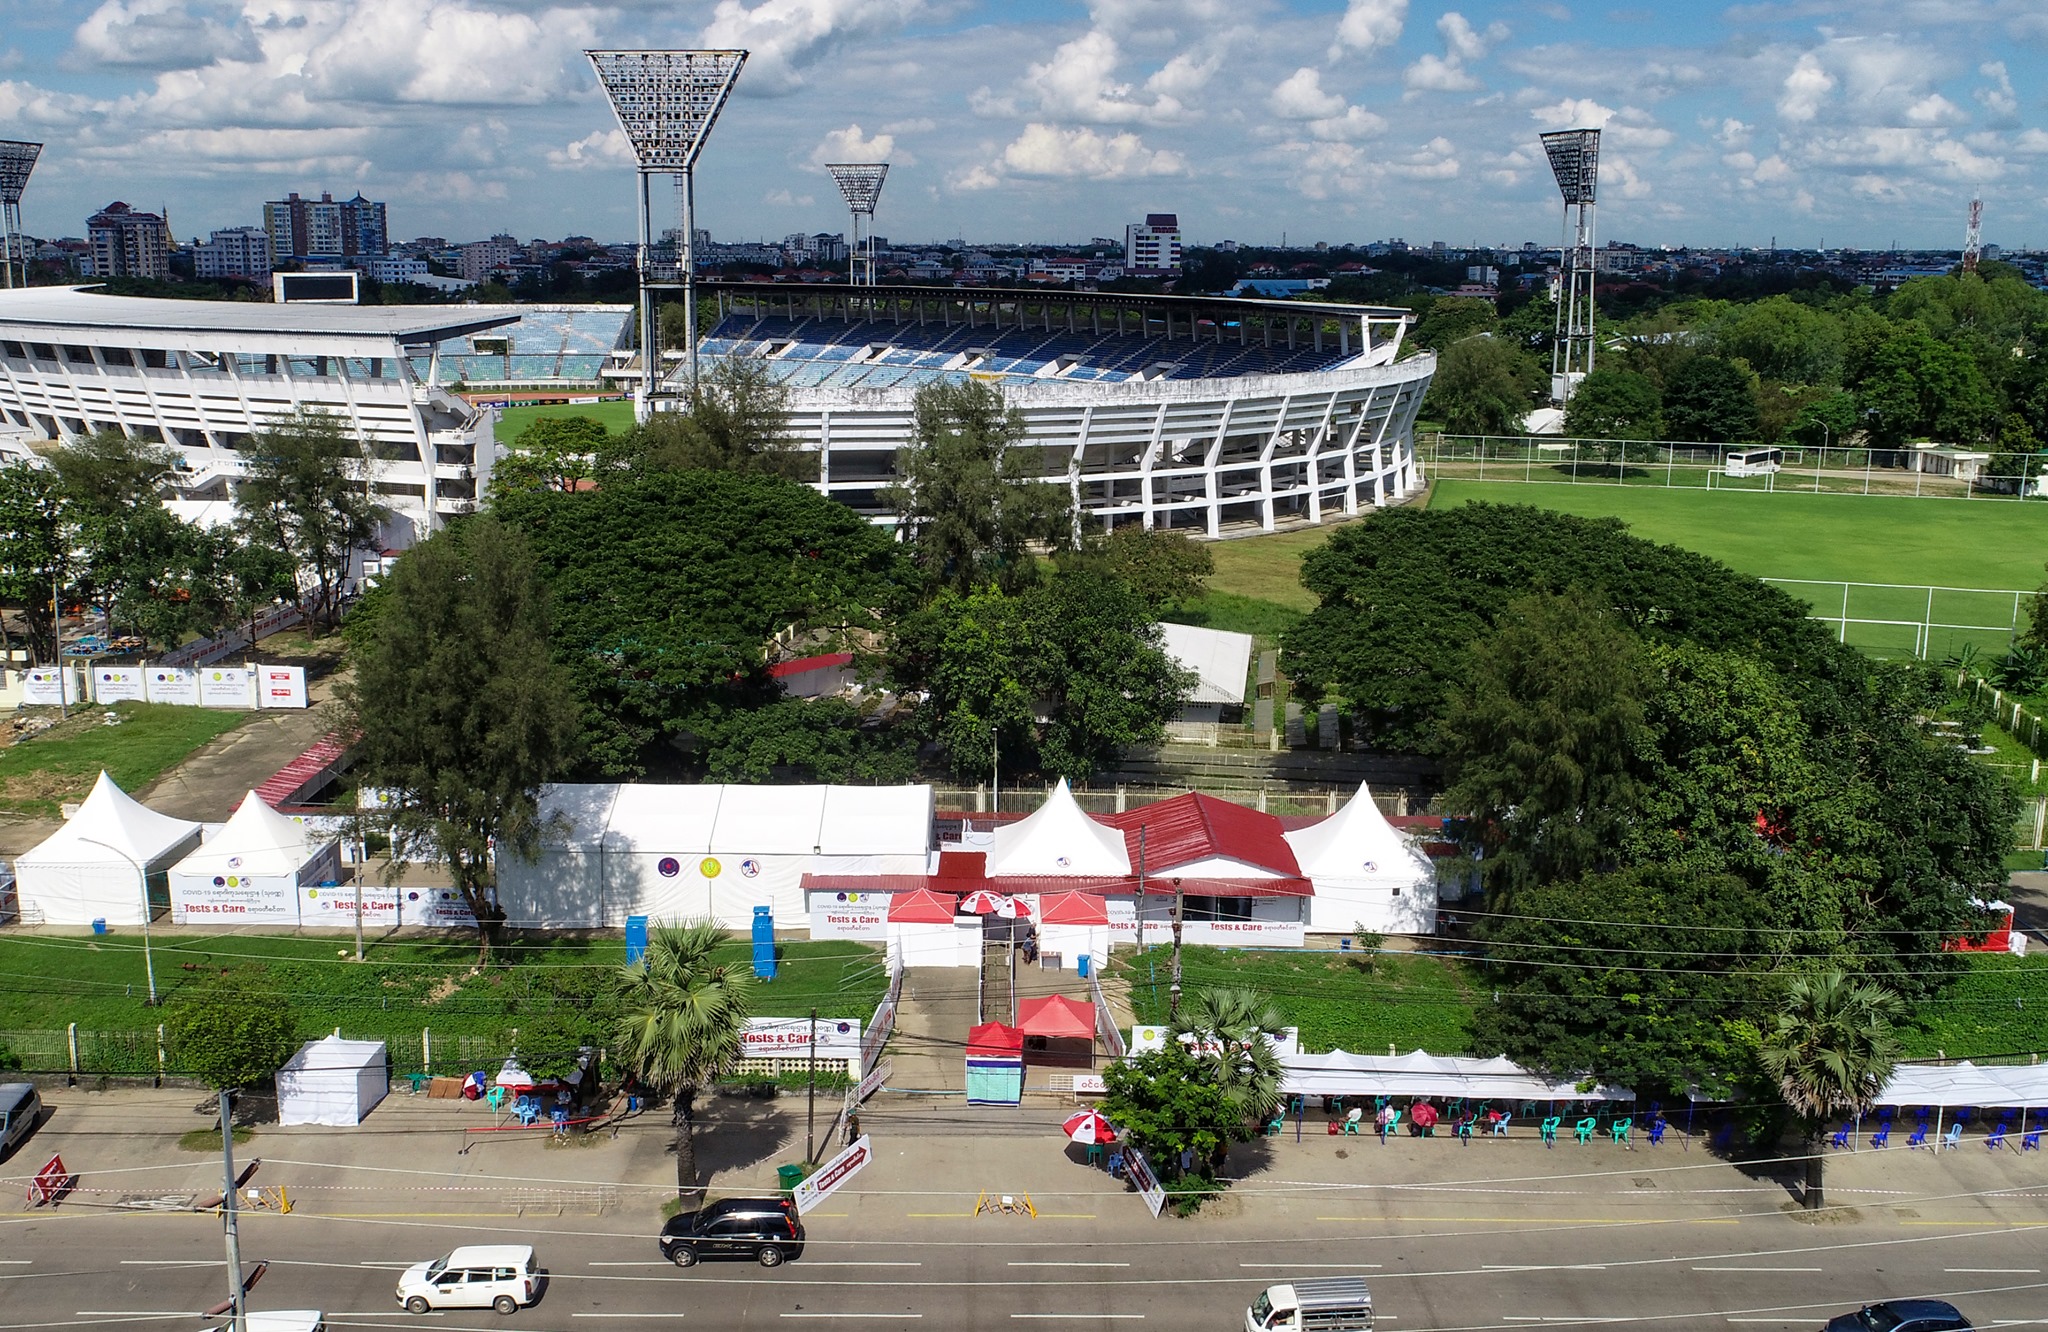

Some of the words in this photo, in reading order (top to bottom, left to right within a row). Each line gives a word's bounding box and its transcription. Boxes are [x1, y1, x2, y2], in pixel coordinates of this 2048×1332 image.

[184, 904, 211, 913] Tests
[213, 904, 220, 913] &
[222, 904, 246, 913] Care
[362, 902, 368, 910] &
[371, 901, 394, 910] Care
[827, 915, 850, 923] Tests
[852, 916, 858, 924] &
[860, 916, 880, 924] Care
[1140, 922, 1158, 930] are
[1210, 922, 1232, 930] Tests
[1242, 923, 1262, 931] Care
[742, 1032, 774, 1044] Tests
[776, 1034, 784, 1043] &
[818, 1176, 831, 1190] Tests
[834, 1164, 845, 1179] Care
